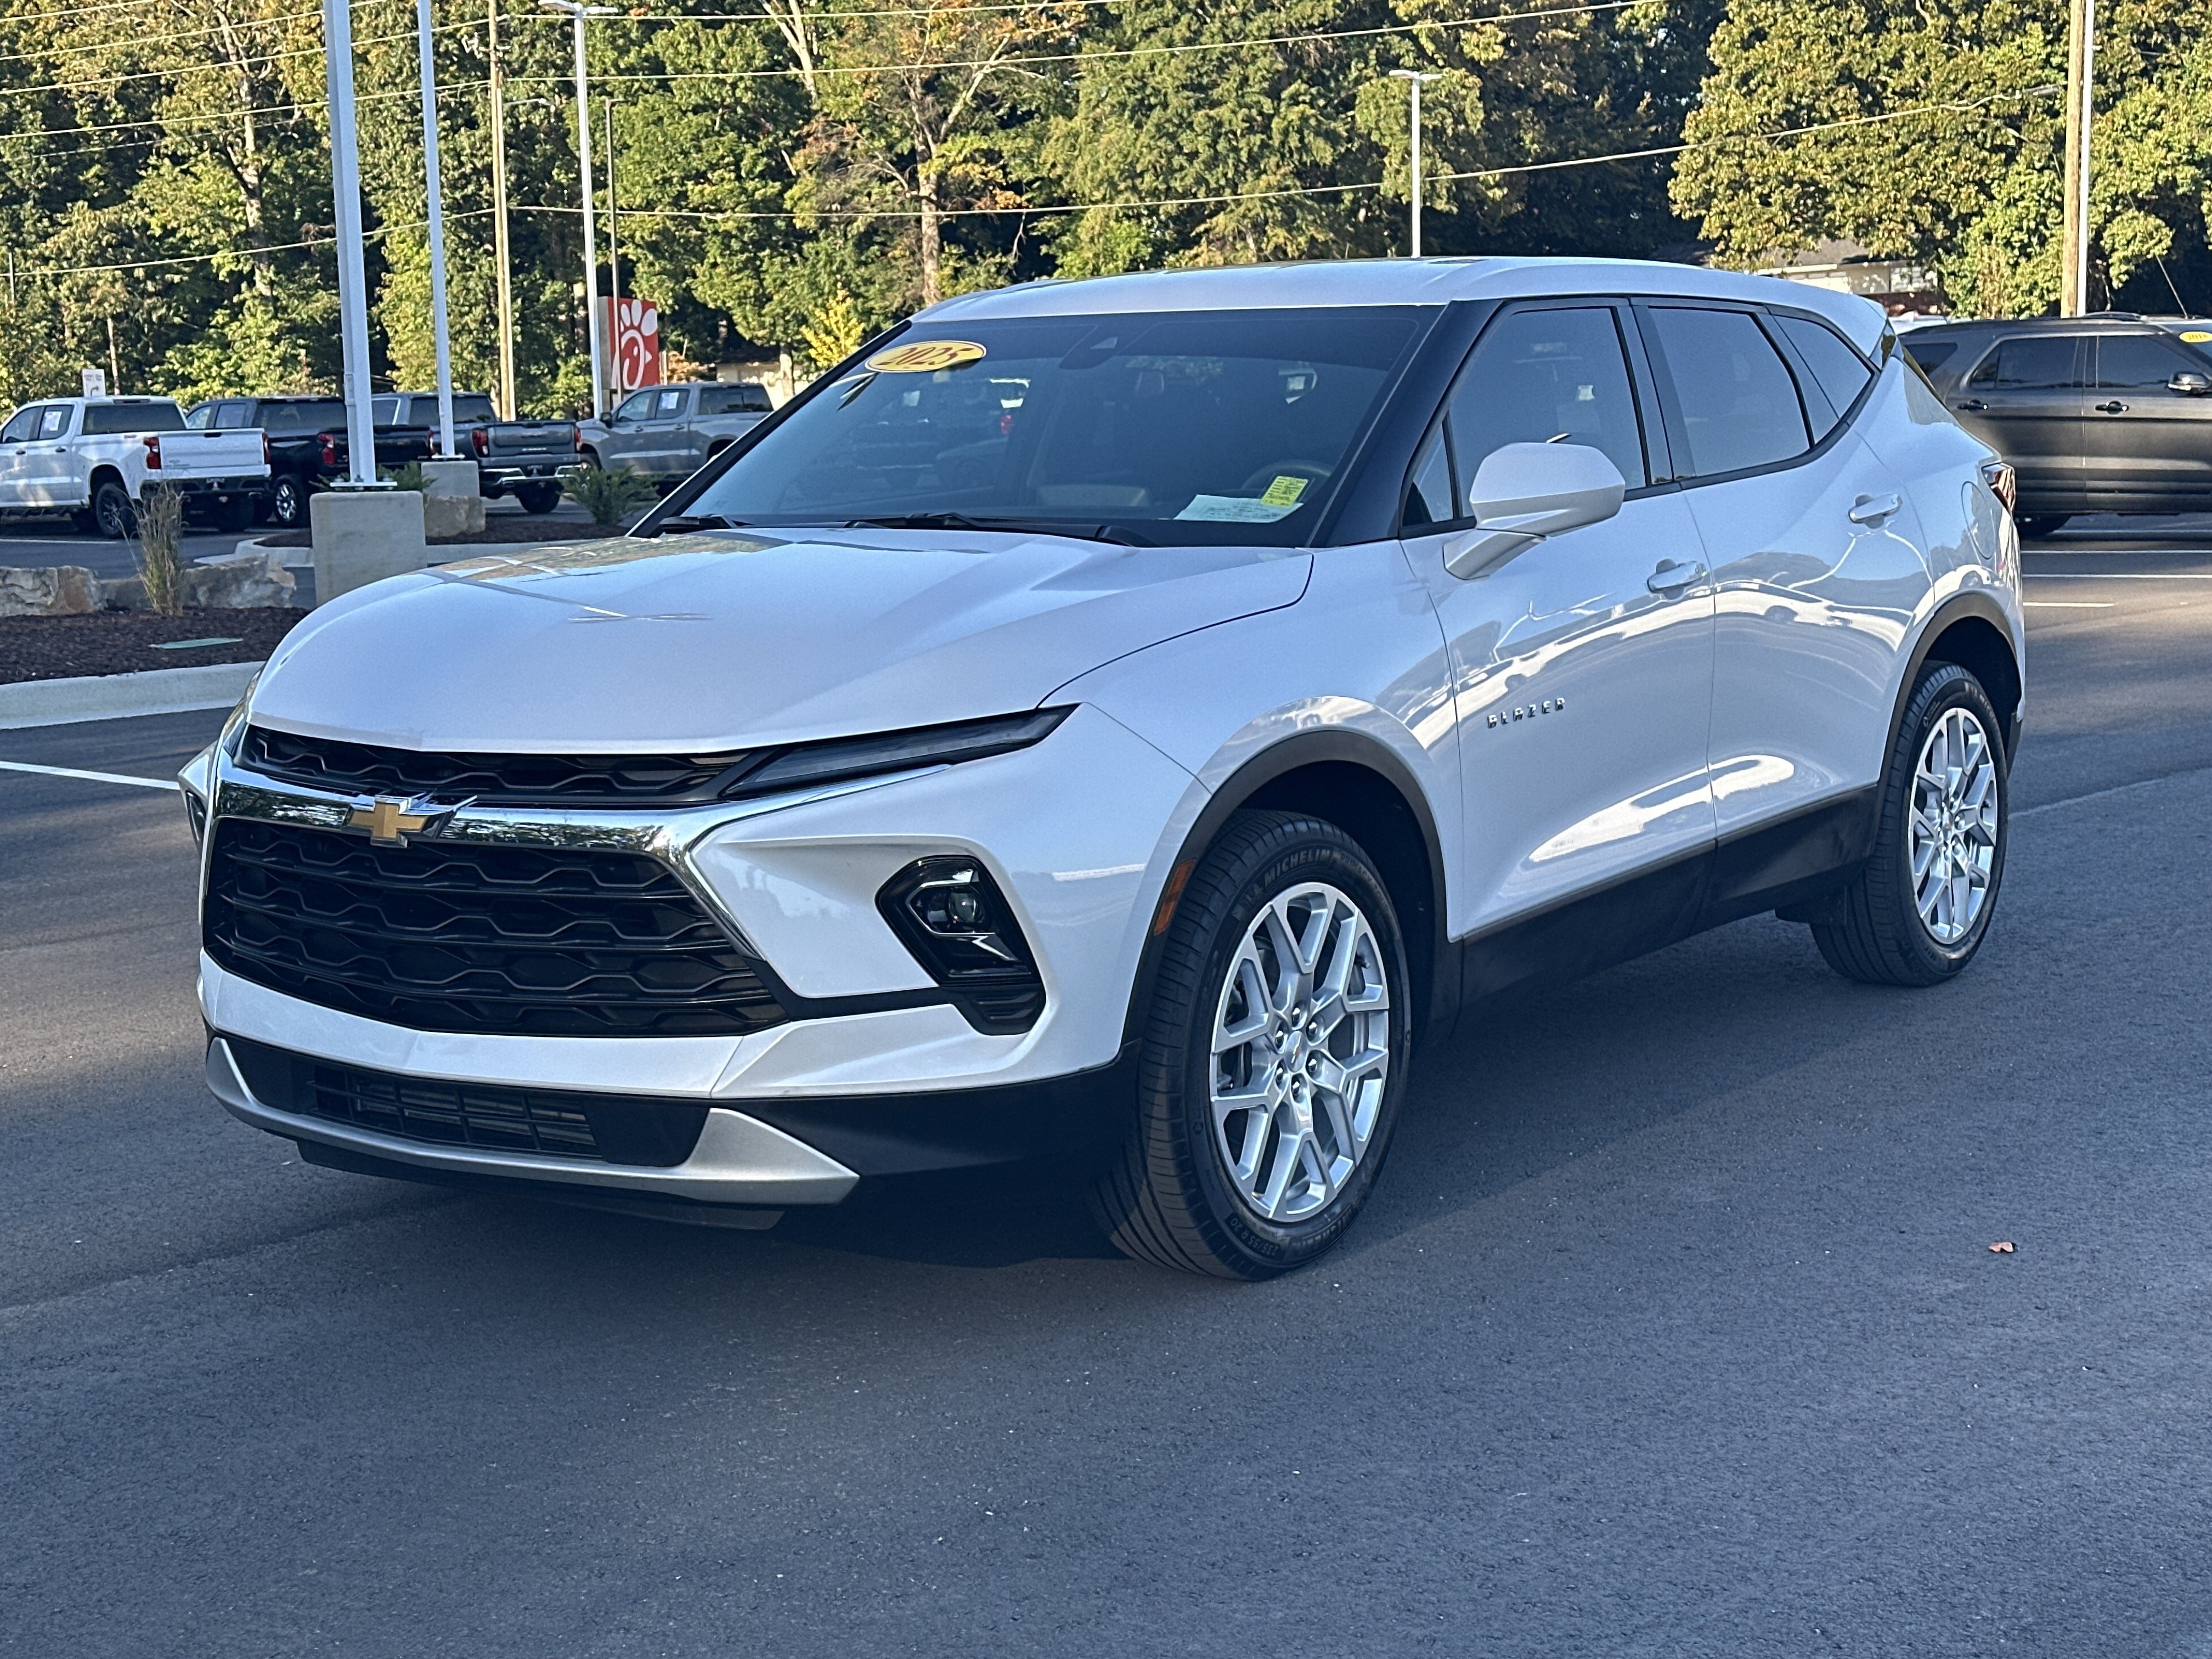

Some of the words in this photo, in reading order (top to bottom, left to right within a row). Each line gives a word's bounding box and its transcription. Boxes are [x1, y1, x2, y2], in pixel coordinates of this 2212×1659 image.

[1487, 697, 1565, 729] BLAZER
[1264, 849, 1330, 888] MICHELIN
[1231, 1217, 1243, 1231] 20
[1248, 1235, 1280, 1256] 235/55
